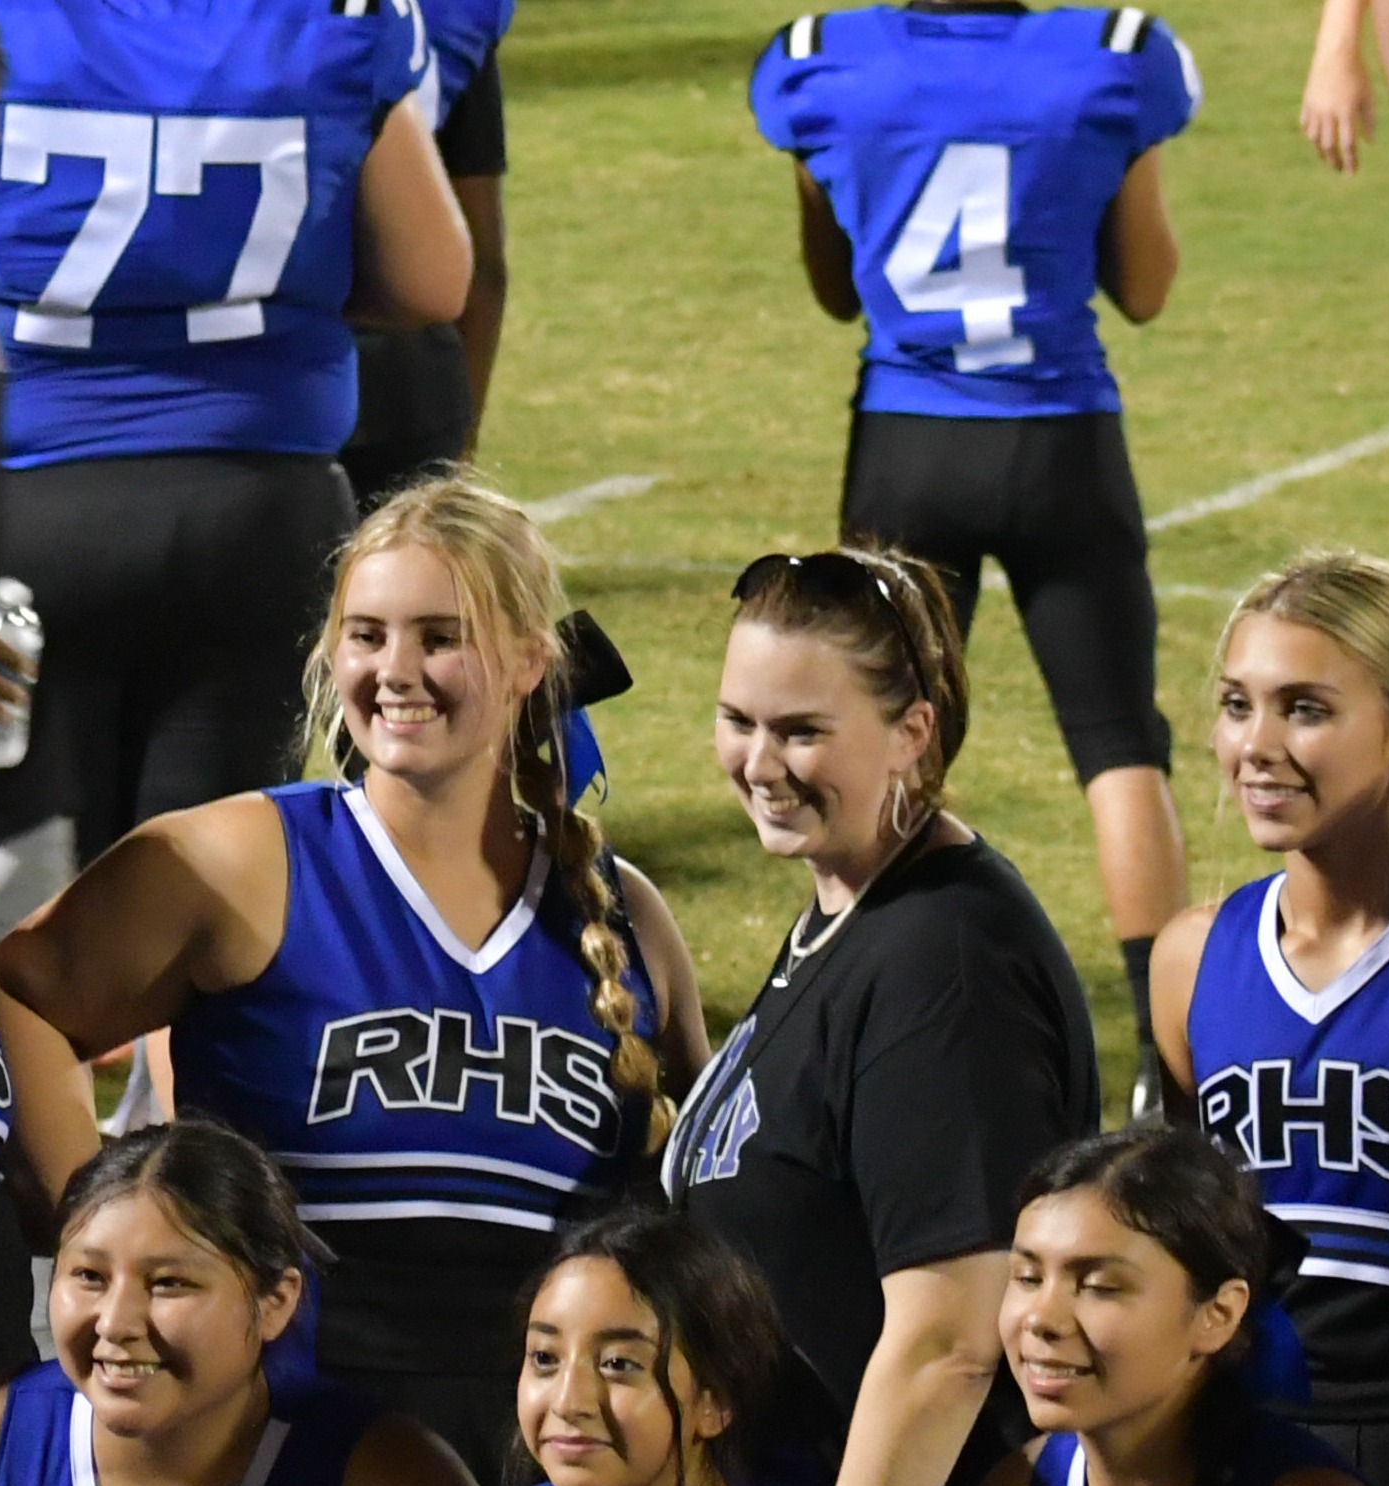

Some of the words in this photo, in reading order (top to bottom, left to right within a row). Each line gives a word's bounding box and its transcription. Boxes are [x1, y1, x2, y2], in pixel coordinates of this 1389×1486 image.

[1, 104, 308, 349] 77
[883, 143, 1035, 372] 4
[308, 1007, 621, 1157] RHS
